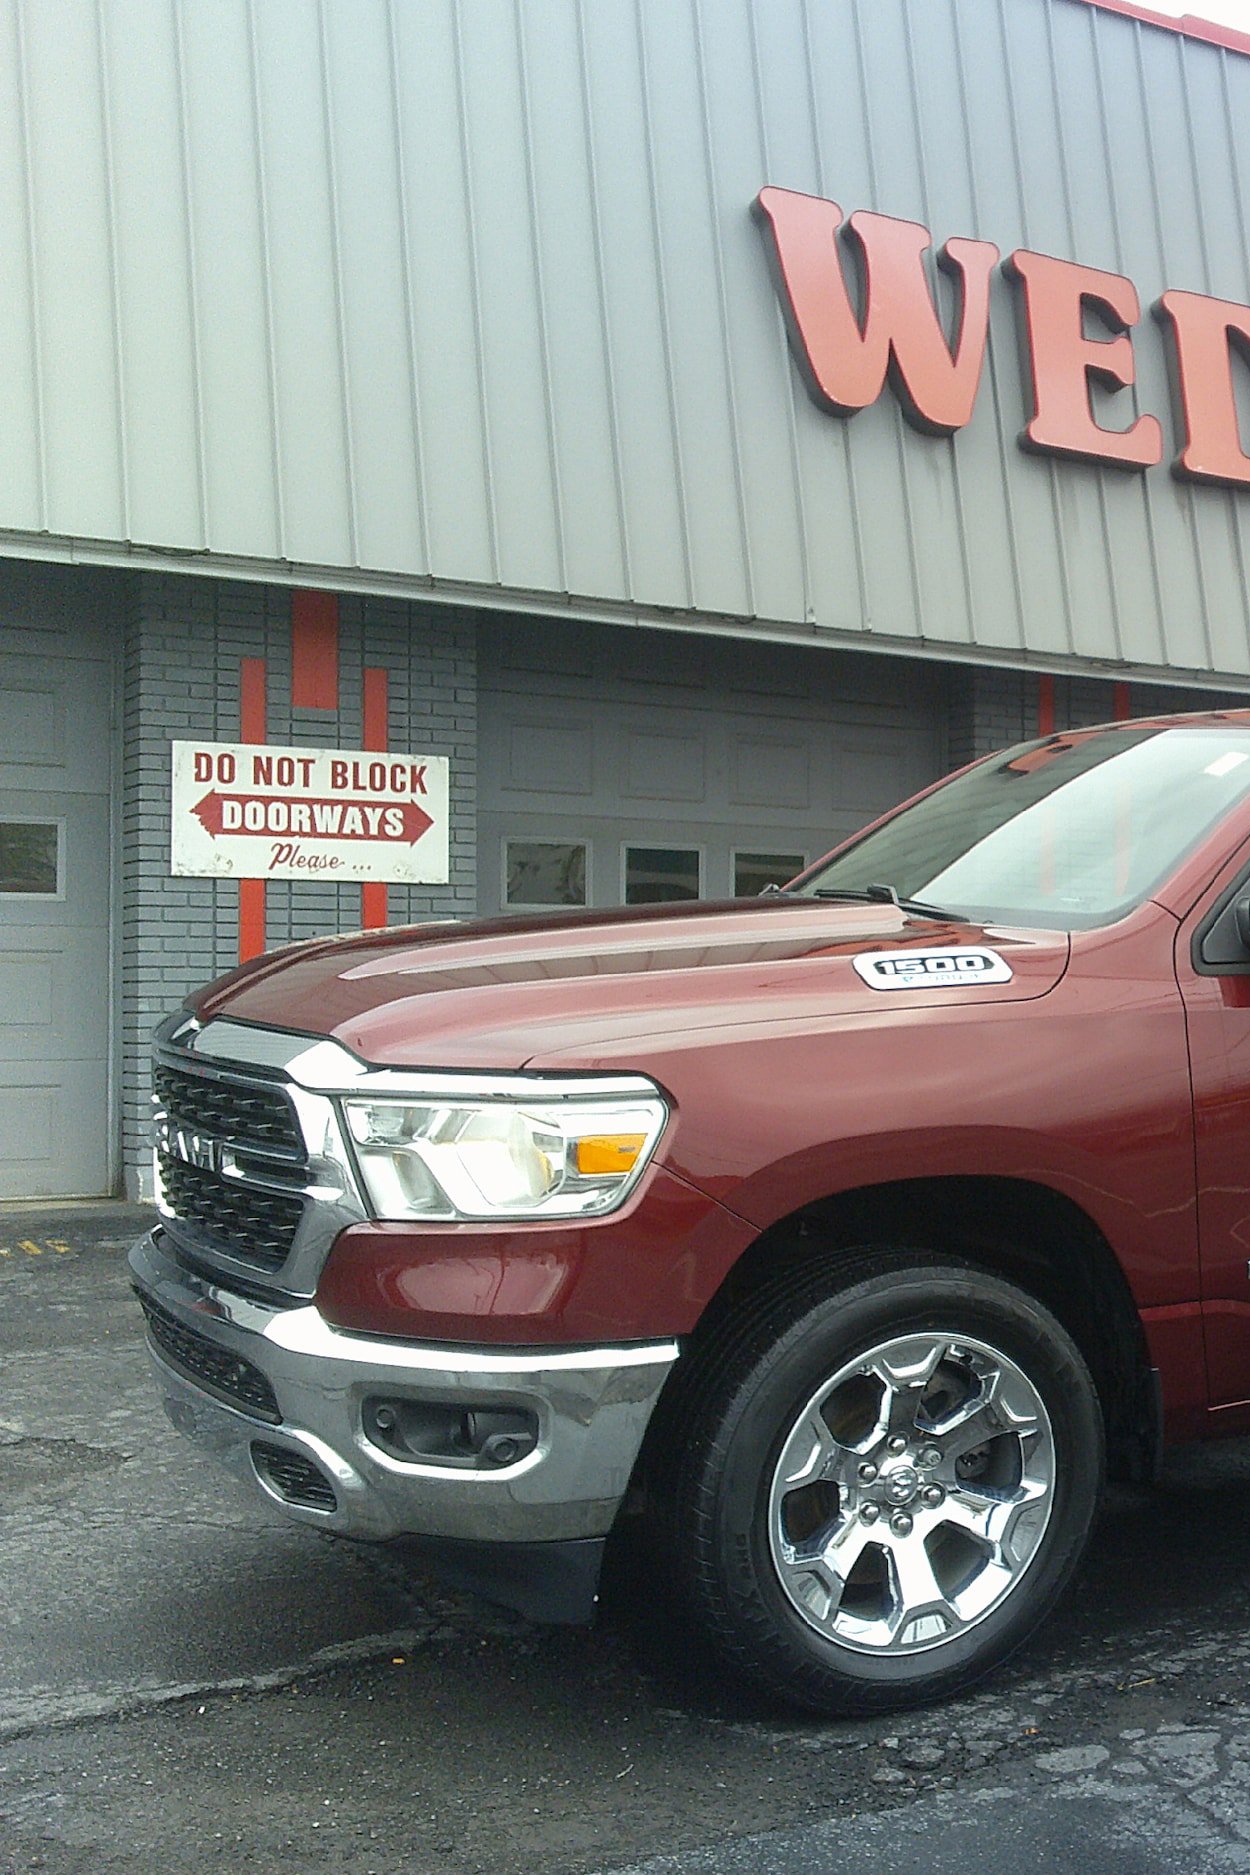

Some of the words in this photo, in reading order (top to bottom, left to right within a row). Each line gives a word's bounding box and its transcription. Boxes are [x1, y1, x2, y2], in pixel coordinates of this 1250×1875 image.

[194, 752, 236, 784] DO
[253, 755, 315, 788] NOT
[331, 760, 428, 795] BLOCK
[222, 800, 404, 837] DOORWAYS
[879, 955, 985, 975] 1500
